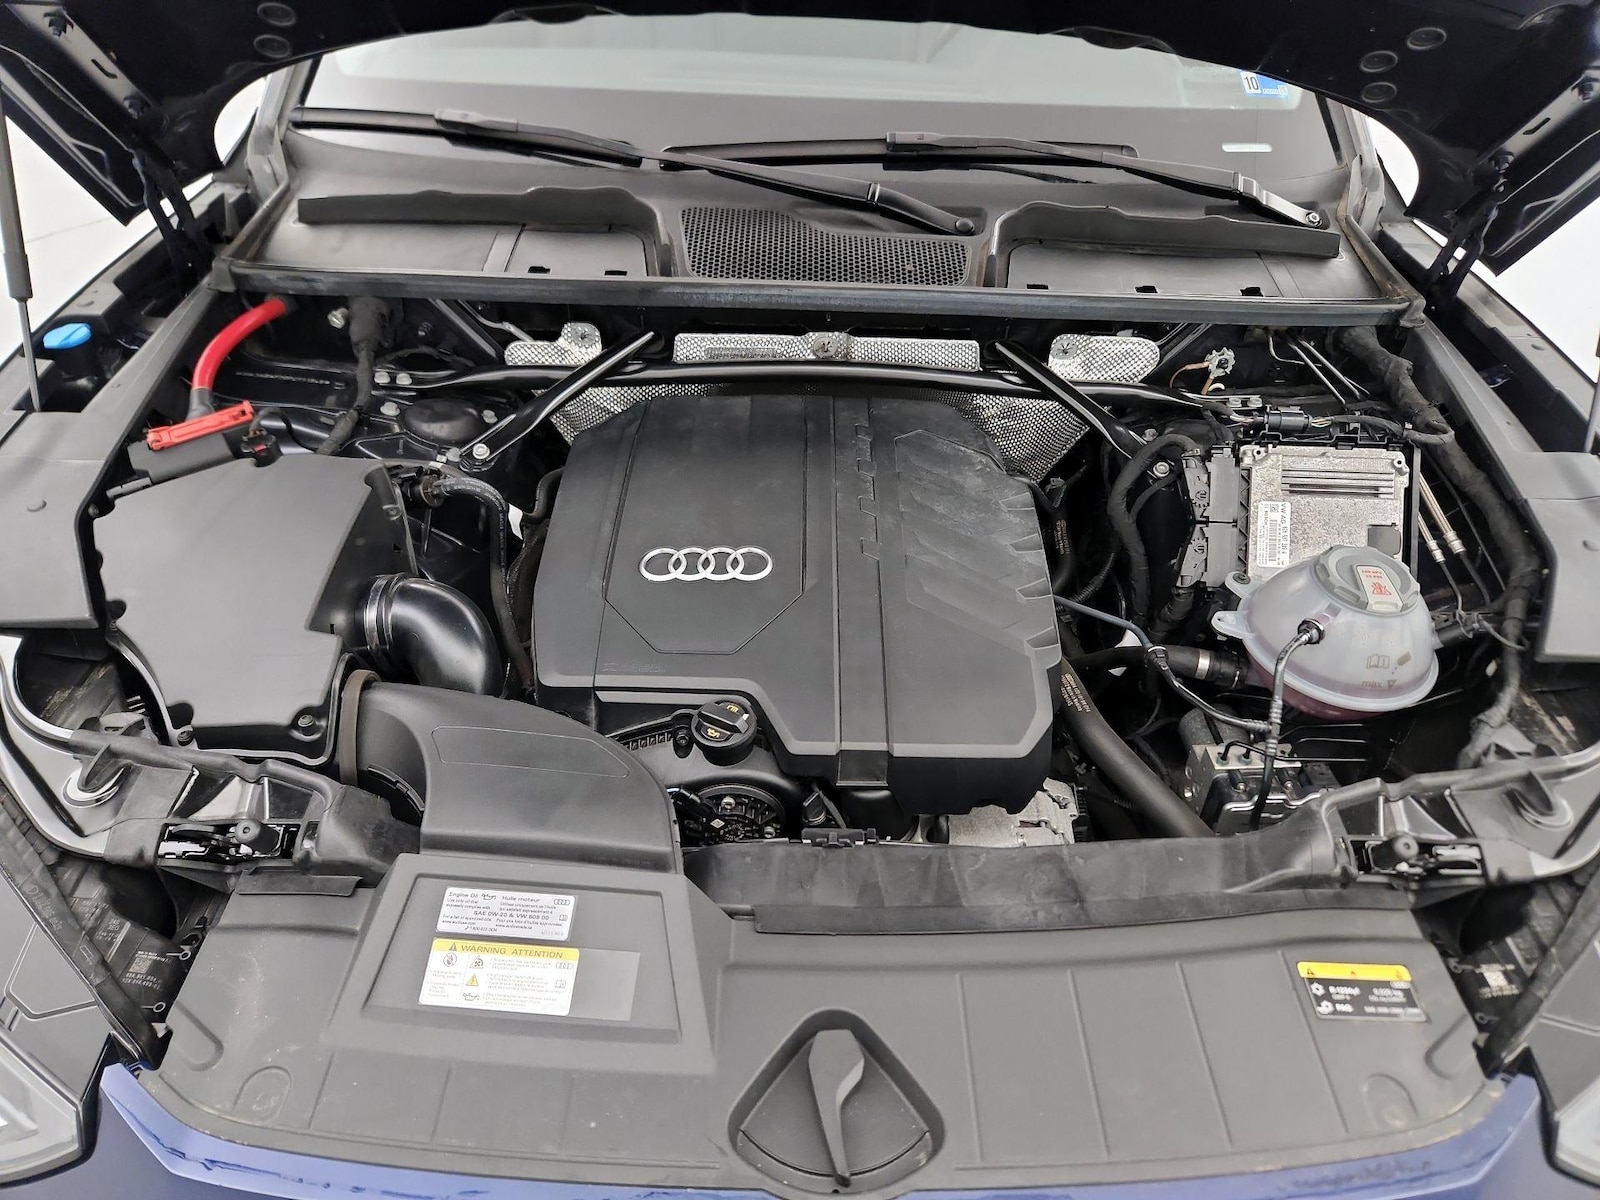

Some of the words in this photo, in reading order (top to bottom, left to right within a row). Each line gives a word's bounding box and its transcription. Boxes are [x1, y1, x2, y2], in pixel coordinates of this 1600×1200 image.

[1244, 76, 1259, 91] 10
[1280, 503, 1287, 514] VW
[1280, 514, 1287, 524] AG
[1361, 680, 1382, 688] max
[461, 944, 506, 955] WARNING
[511, 948, 563, 959] ATTENTION
